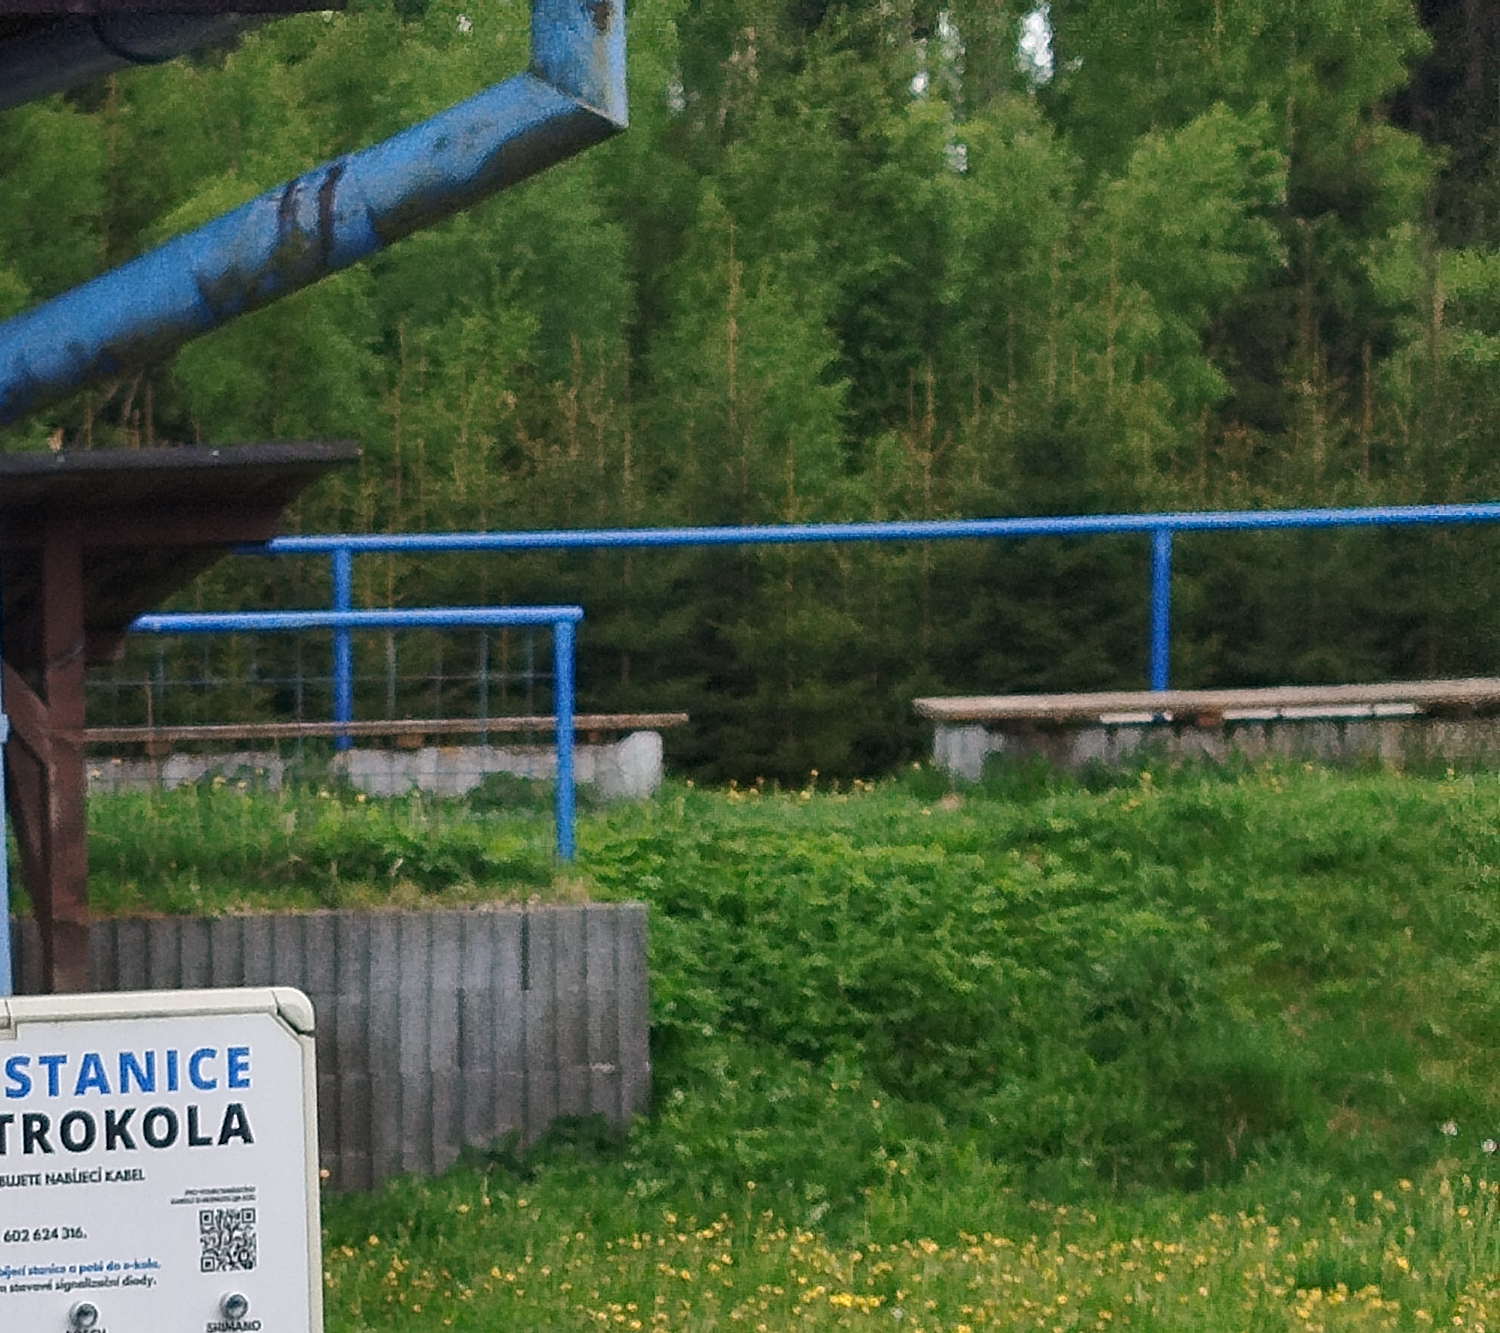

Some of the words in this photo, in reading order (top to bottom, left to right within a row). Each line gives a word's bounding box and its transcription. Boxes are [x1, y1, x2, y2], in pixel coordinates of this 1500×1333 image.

[4, 1047, 250, 1098] STANICE
[45, 1166, 102, 1185] NABÍJECÍ
[105, 1168, 146, 1182] KABEL
[3, 1229, 29, 1243] 602
[33, 1228, 58, 1241] 624
[206, 1320, 262, 1333] SHIMANO
